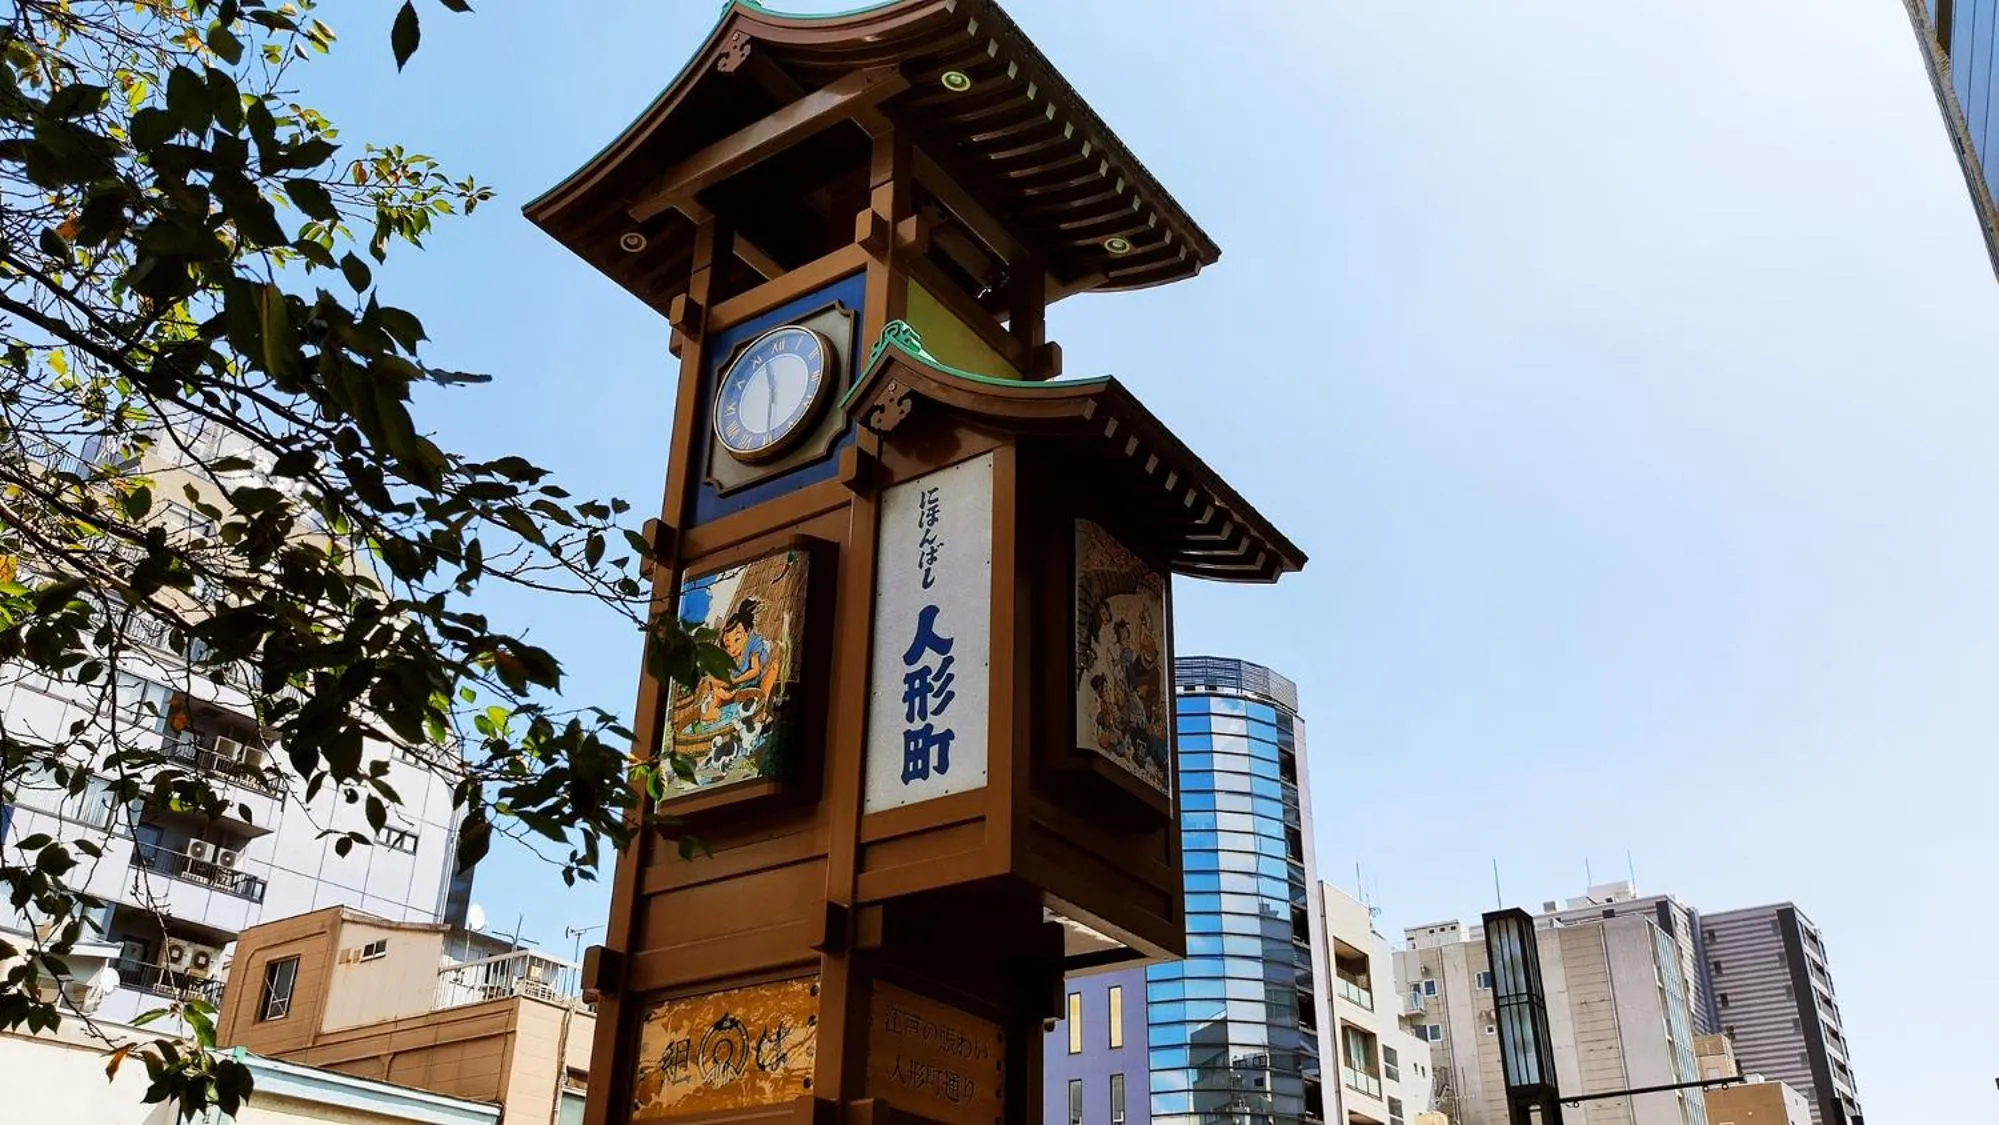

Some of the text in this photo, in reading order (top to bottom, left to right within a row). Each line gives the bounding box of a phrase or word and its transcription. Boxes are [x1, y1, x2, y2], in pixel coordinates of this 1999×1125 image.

[901, 487, 955, 786] にほんばし 人形町
[888, 1054, 976, 1103] 人形町通り
